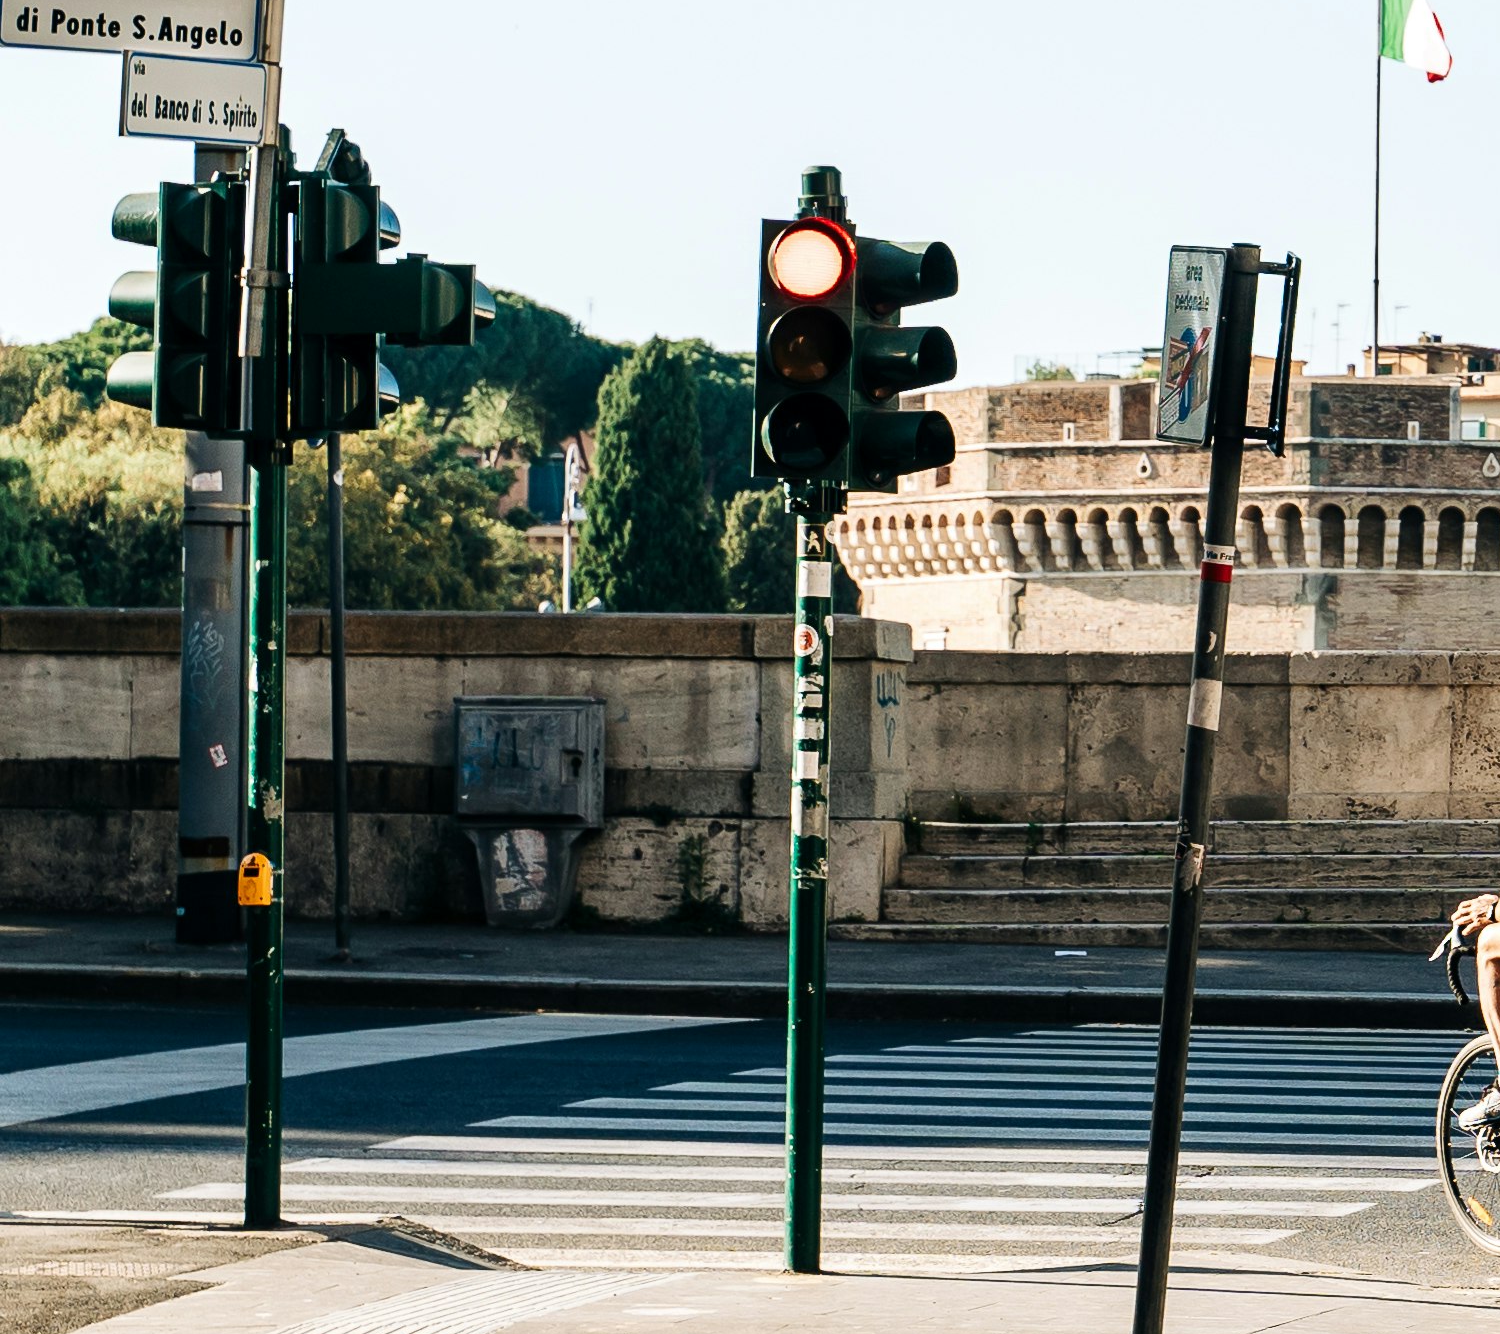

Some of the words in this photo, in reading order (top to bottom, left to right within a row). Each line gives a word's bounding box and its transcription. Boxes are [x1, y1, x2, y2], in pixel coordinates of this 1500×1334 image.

[16, 7, 39, 33] di
[51, 8, 121, 38] Ponte
[133, 60, 146, 75] via
[131, 92, 148, 118] del
[154, 94, 189, 122] Banco
[192, 99, 203, 124] di
[208, 101, 218, 125] S.
[223, 101, 258, 132] Spirito
[1186, 265, 1203, 281] area
[1174, 290, 1210, 313] pedonale
